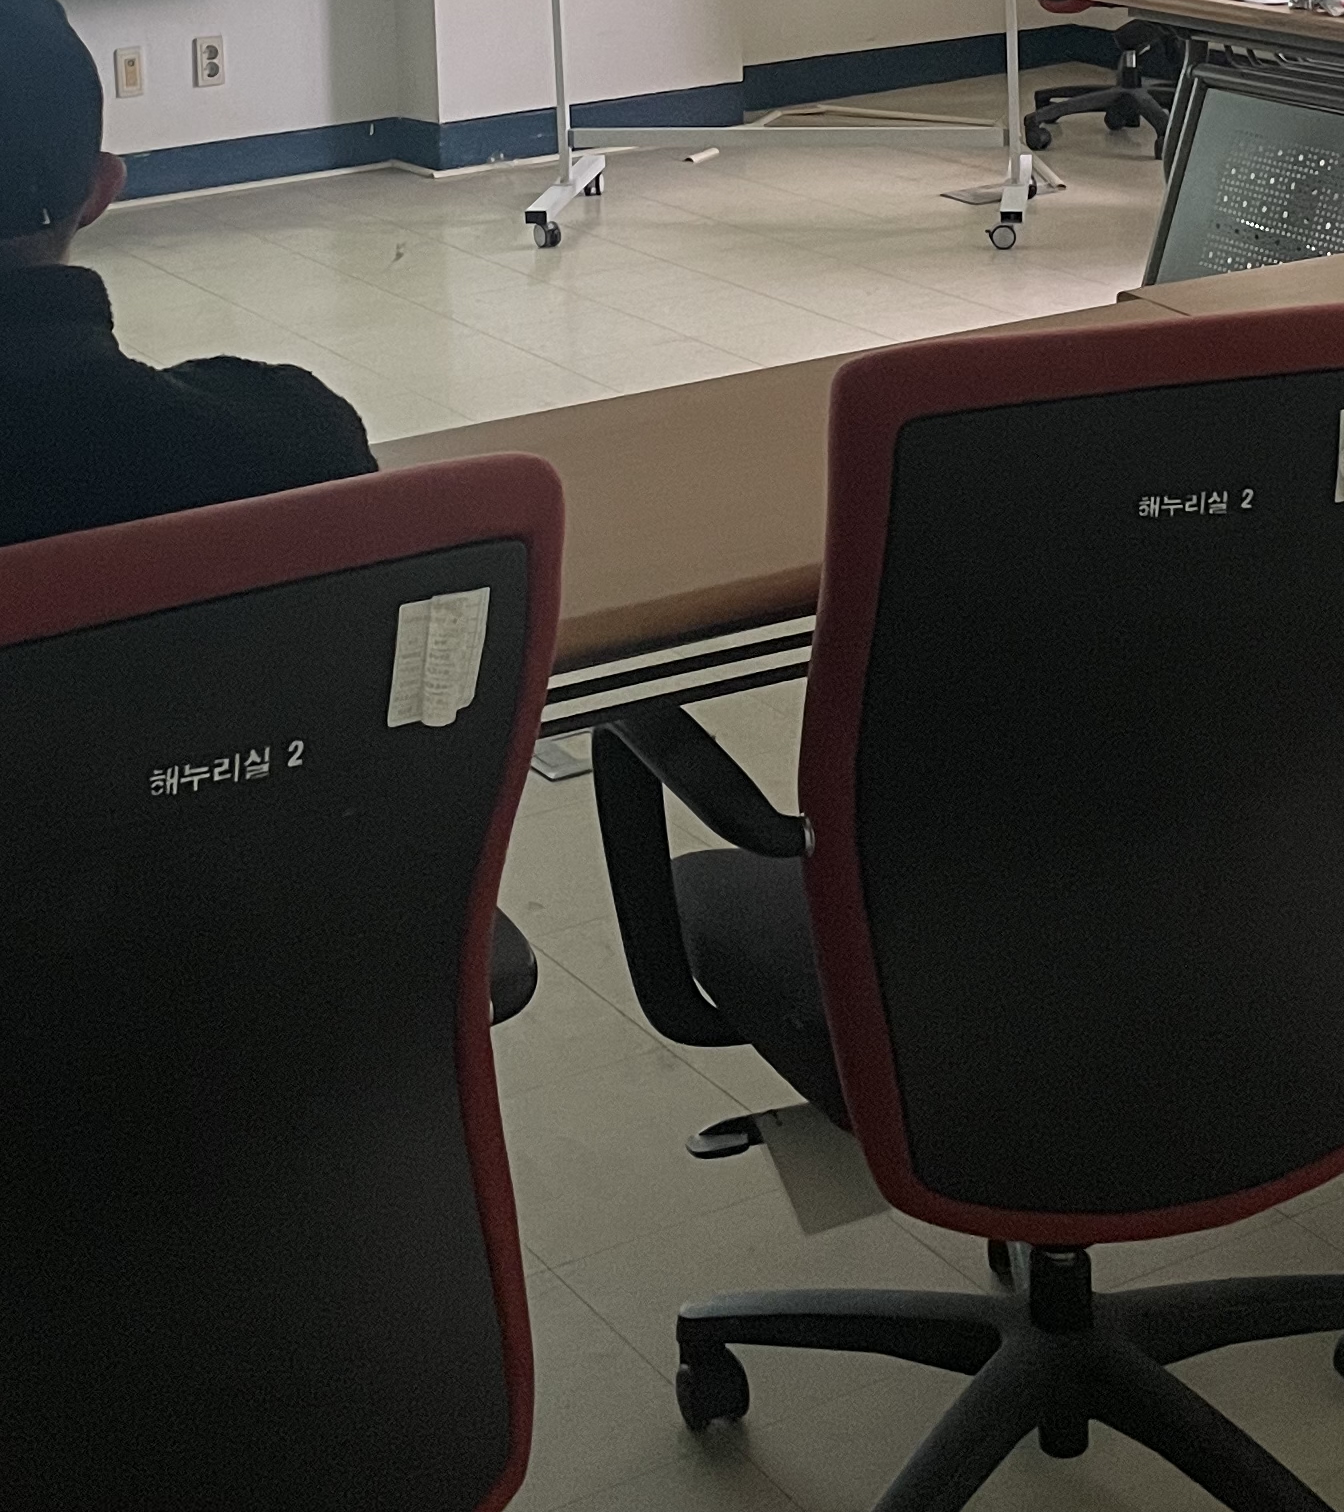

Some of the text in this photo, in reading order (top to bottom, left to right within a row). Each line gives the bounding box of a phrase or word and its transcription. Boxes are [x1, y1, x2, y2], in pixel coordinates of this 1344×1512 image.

[1138, 489, 1254, 517] 해누리실 2
[150, 740, 305, 796] 해누리실 2
